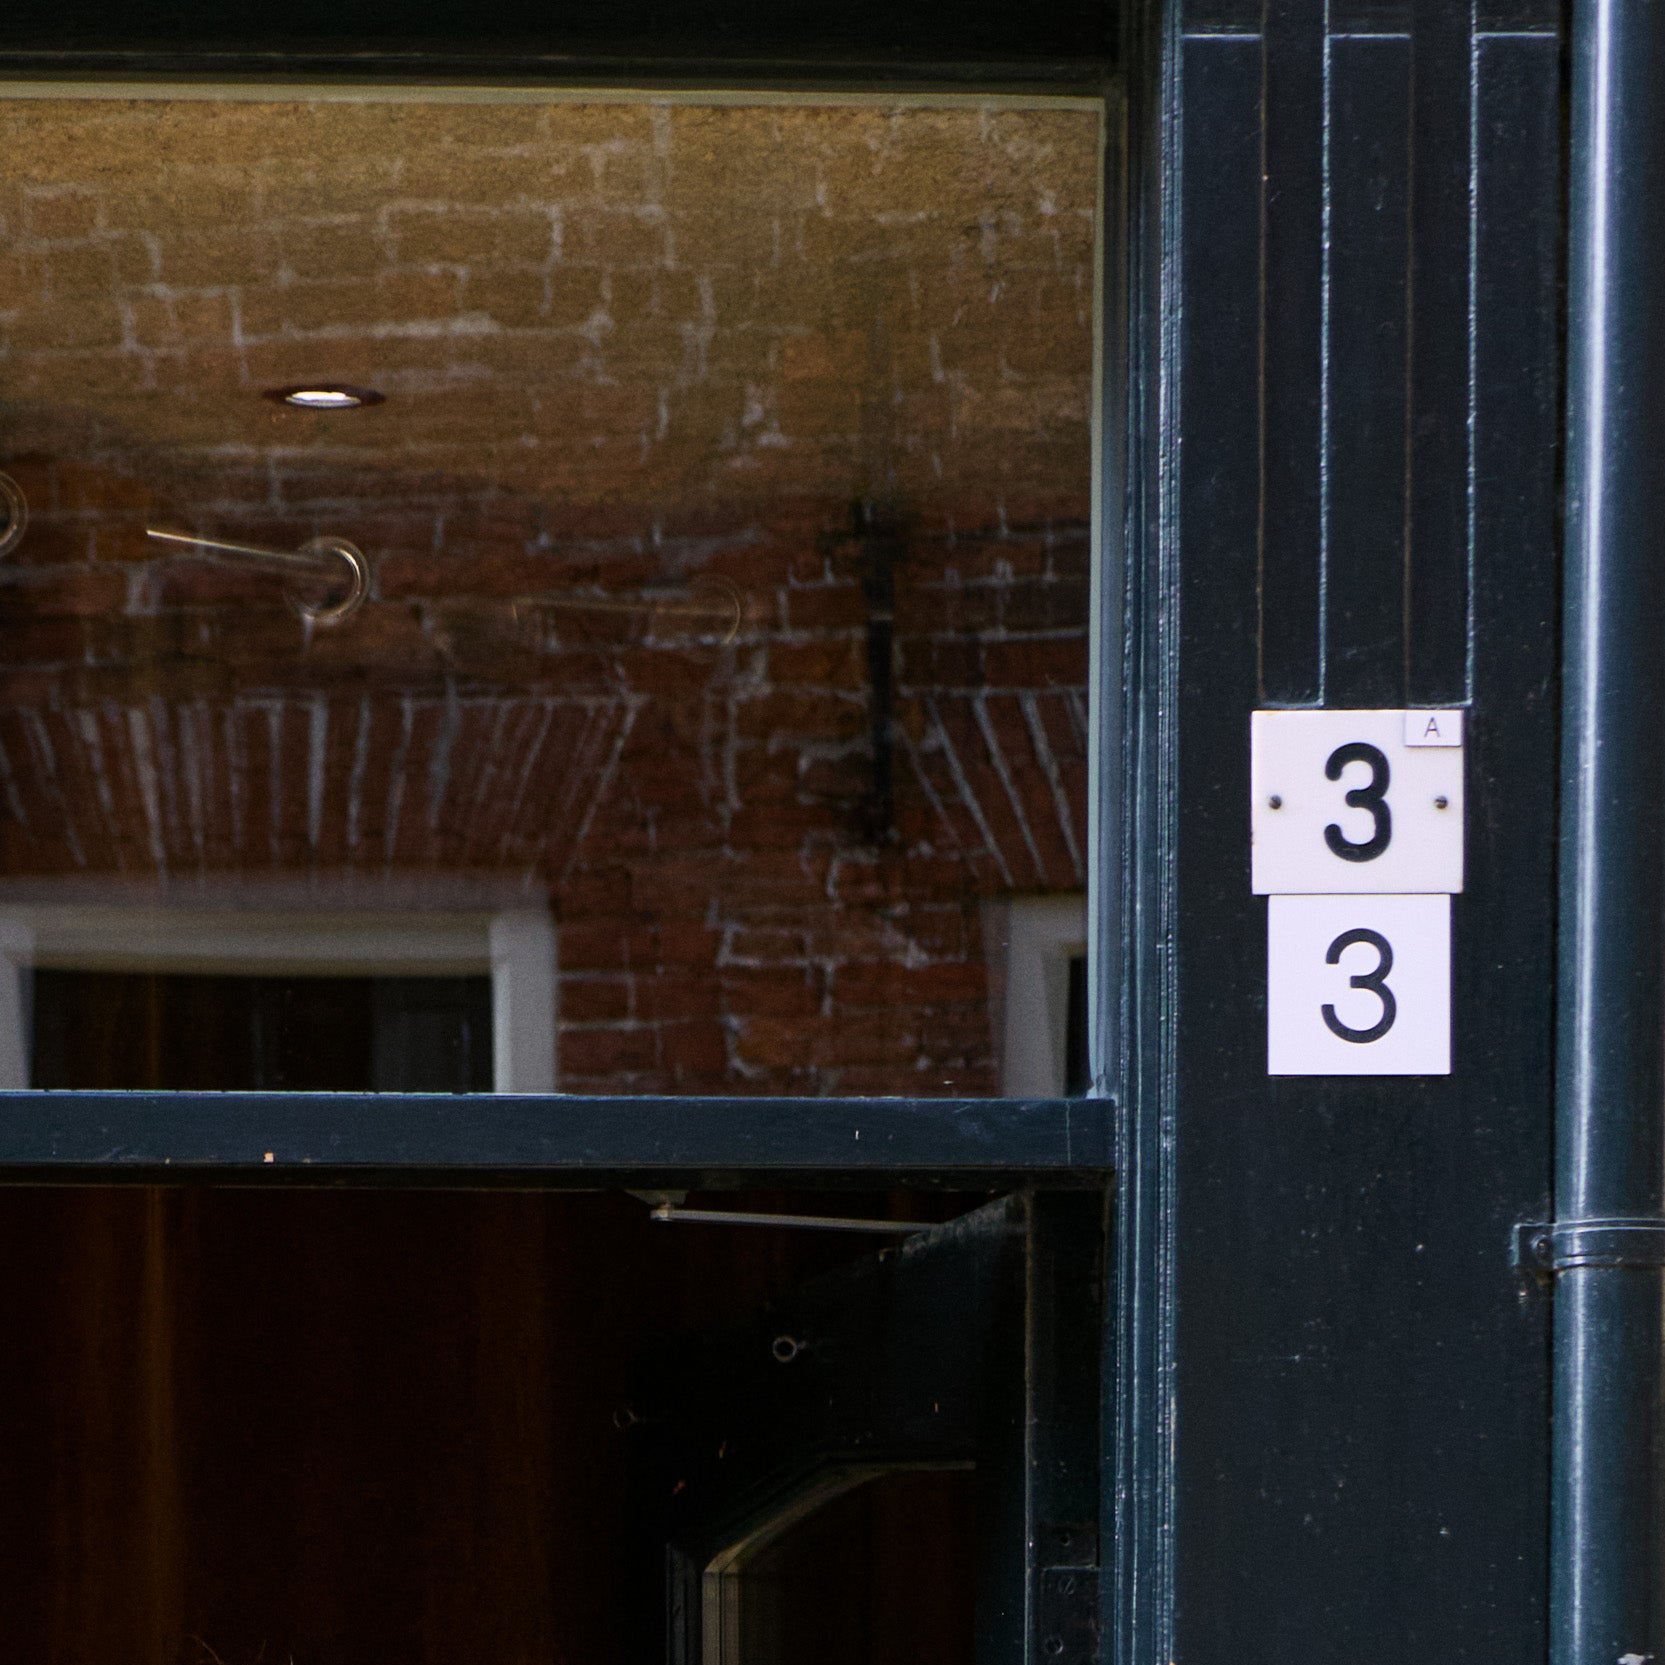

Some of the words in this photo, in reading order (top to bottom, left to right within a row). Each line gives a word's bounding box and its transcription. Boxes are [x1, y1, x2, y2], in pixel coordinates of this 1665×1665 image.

[1424, 717, 1441, 738] A
[1324, 742, 1392, 863] 3
[1321, 928, 1397, 1044] 3
